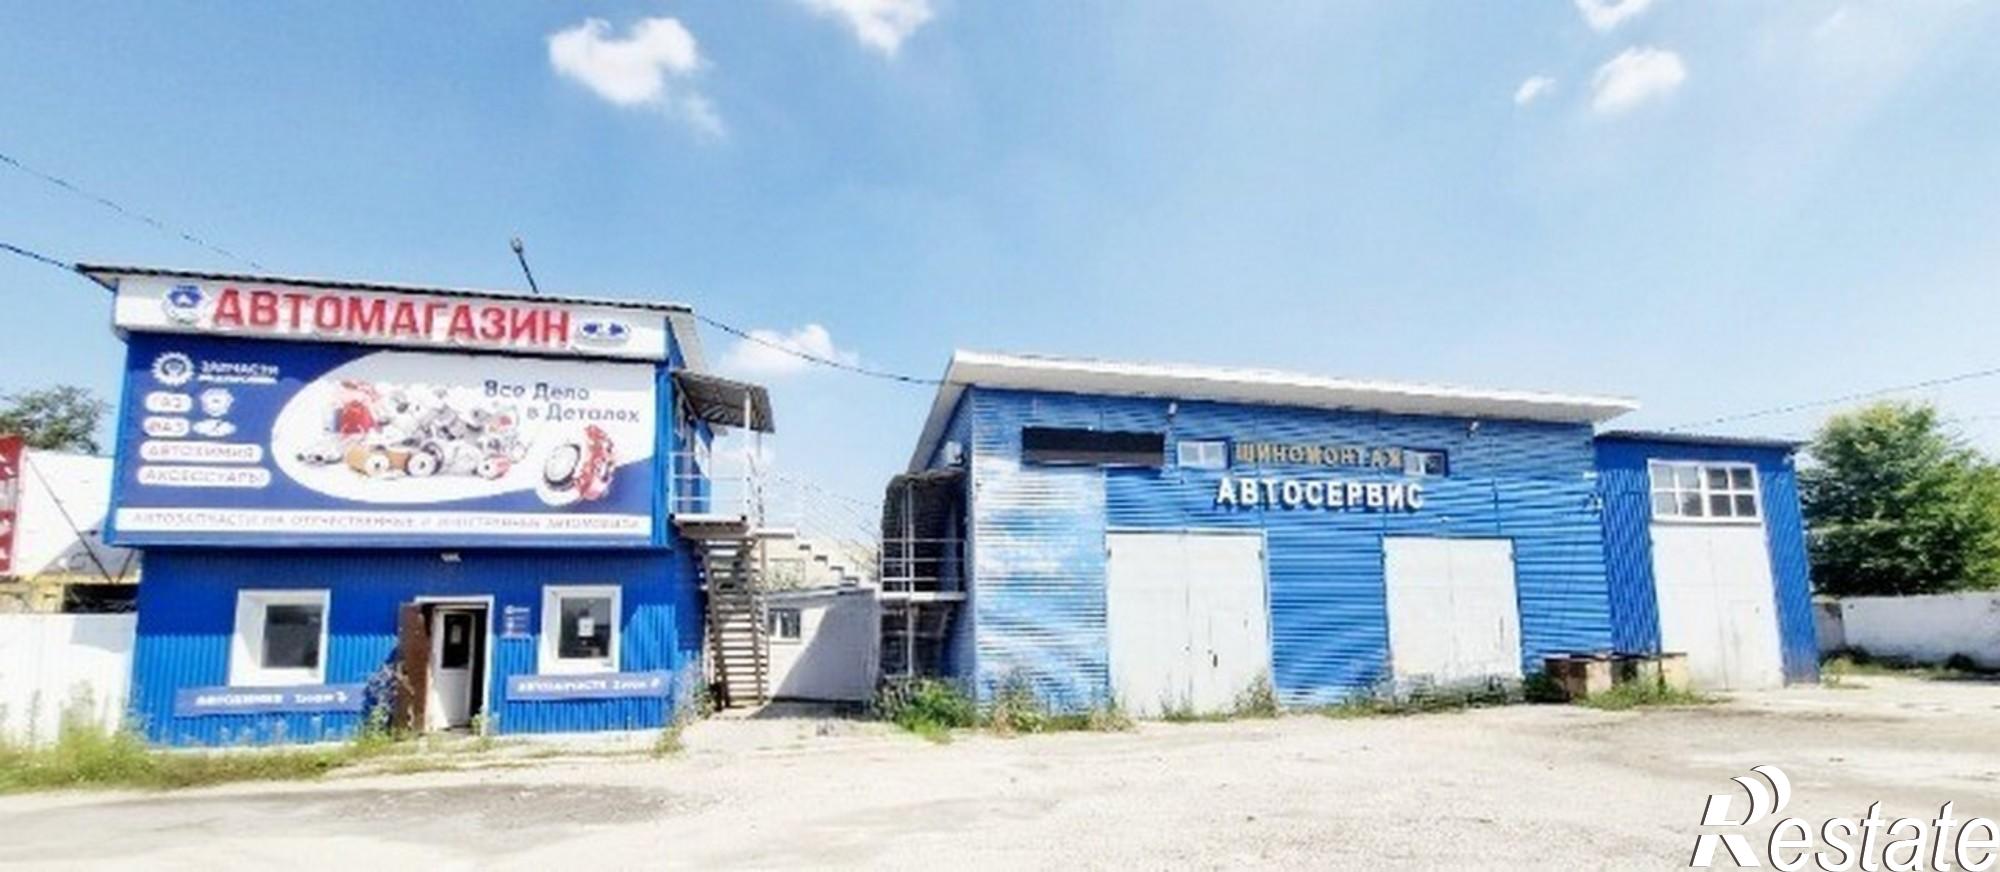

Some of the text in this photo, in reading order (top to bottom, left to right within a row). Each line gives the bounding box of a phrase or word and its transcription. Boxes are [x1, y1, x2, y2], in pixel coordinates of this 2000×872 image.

[212, 287, 571, 348] АВТОМАГАЗИН
[201, 360, 279, 375] ЗАПЧАСТИ
[533, 382, 590, 401] Дело
[148, 444, 254, 459] АВТОХИМИЯ
[1236, 442, 1403, 469] ШИНОМОНТАЖ
[144, 468, 265, 484] АКСЕССУАРЫ
[1216, 476, 1425, 510] АВТОСЕРВИС
